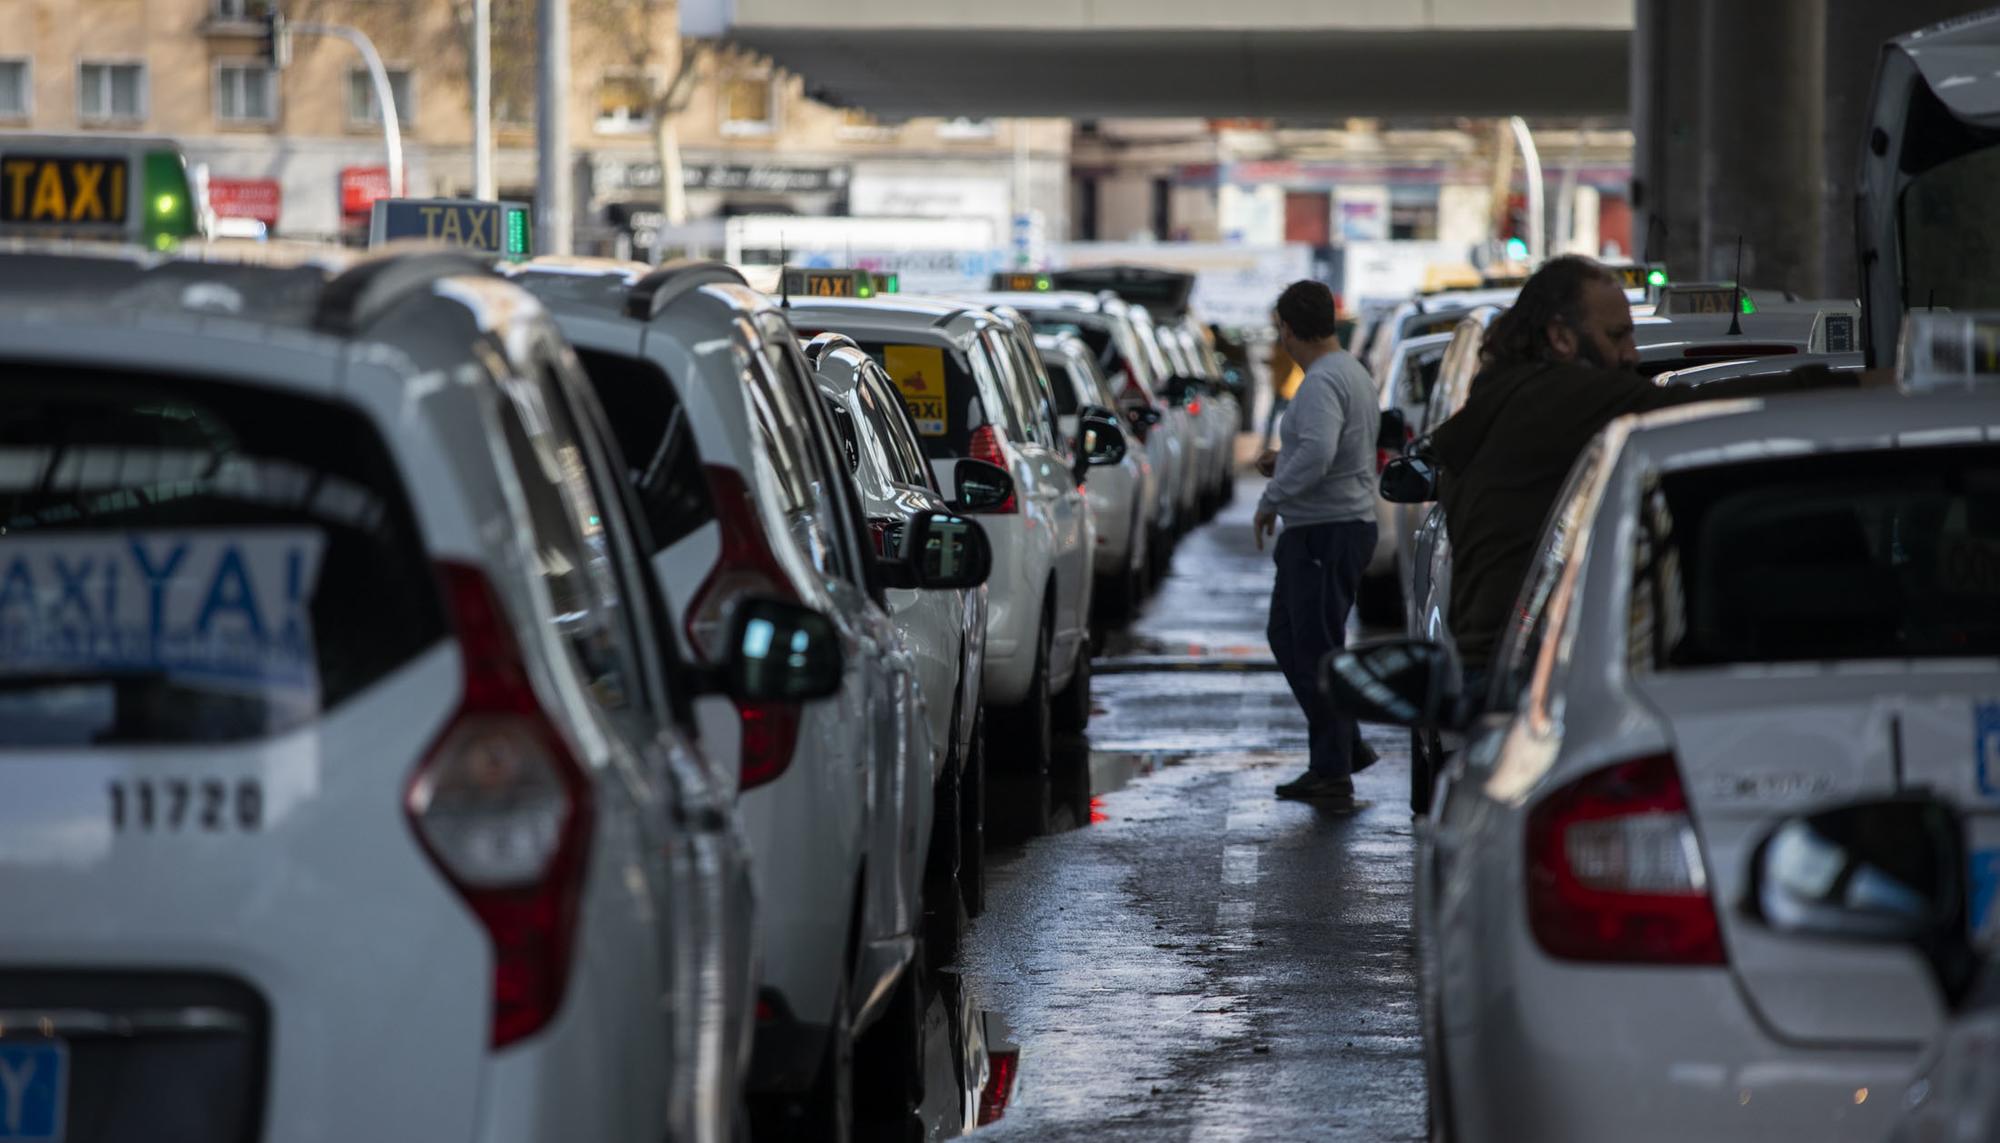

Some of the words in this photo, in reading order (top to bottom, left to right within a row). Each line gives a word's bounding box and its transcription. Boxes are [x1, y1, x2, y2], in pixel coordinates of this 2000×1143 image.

[3, 161, 125, 221] TAXI
[420, 207, 499, 250] TAXI
[810, 277, 851, 296] TAXI
[1693, 292, 1733, 314] TAX
[906, 400, 944, 420] axi
[110, 780, 264, 832] 11720
